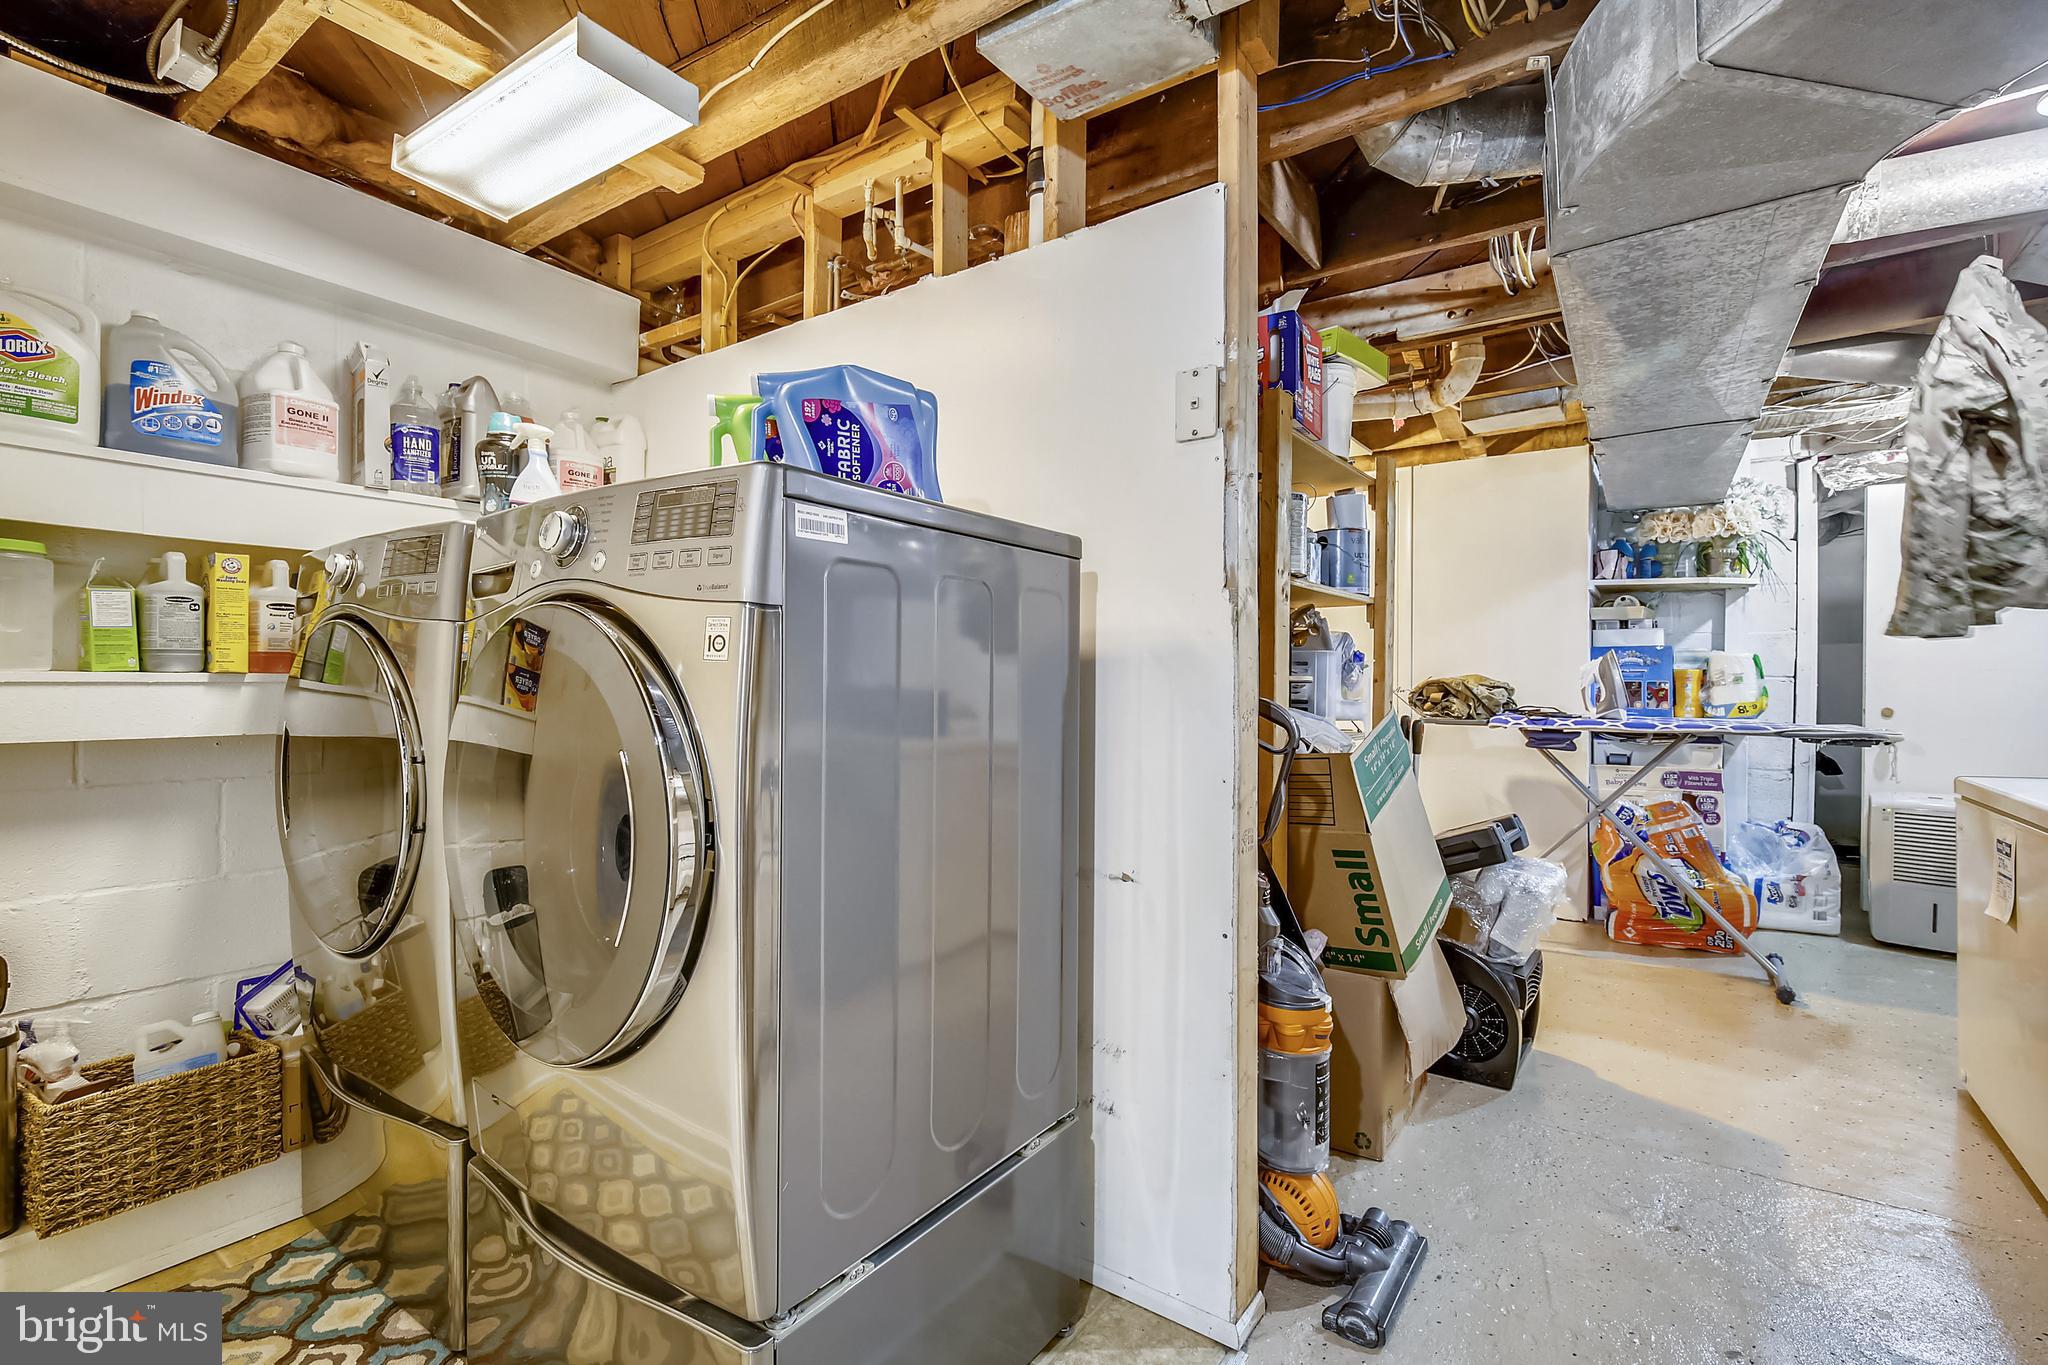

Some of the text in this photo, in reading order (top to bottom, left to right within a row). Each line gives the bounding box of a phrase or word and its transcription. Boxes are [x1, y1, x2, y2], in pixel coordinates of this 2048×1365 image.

[367, 378, 389, 386] Degree
[134, 386, 204, 413] Windex
[287, 407, 319, 419] GONE
[804, 401, 812, 417] 197
[402, 436, 432, 451] HAND
[837, 418, 851, 481] FABRIC
[851, 423, 861, 481] SOFTENER
[402, 448, 432, 458] SANITIZER
[568, 469, 591, 478] GONE
[707, 634, 726, 652] 10
[1364, 741, 1380, 767] Small
[1331, 849, 1390, 948] Small
[1415, 925, 1429, 950] Small
